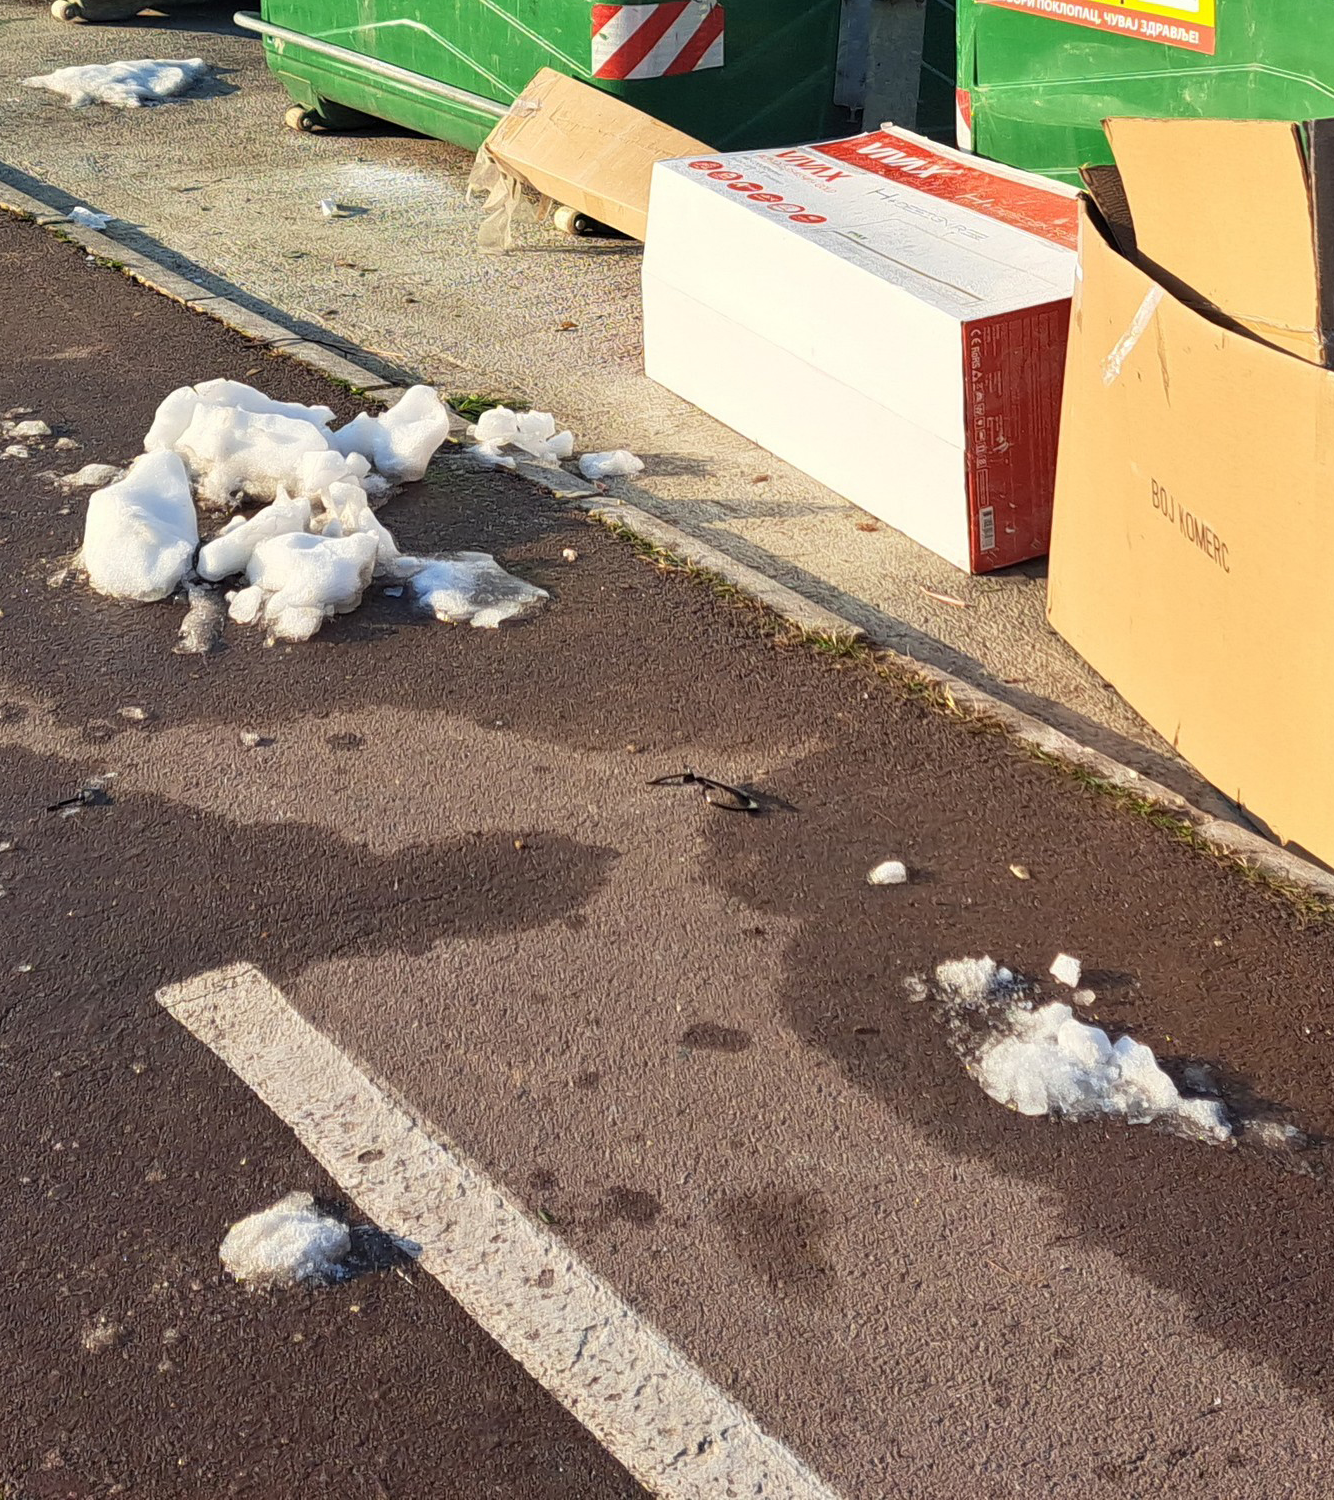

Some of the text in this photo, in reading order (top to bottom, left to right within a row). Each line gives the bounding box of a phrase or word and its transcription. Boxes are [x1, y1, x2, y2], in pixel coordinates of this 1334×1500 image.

[1103, 12, 1138, 30] ЧУВАЈ
[1140, 19, 1199, 44] ЗДРАВЉЕ!
[775, 150, 854, 182] VIVAX
[856, 142, 963, 178] VIVAX
[1151, 477, 1174, 523] BOJ
[1178, 502, 1230, 574] KOMERC
